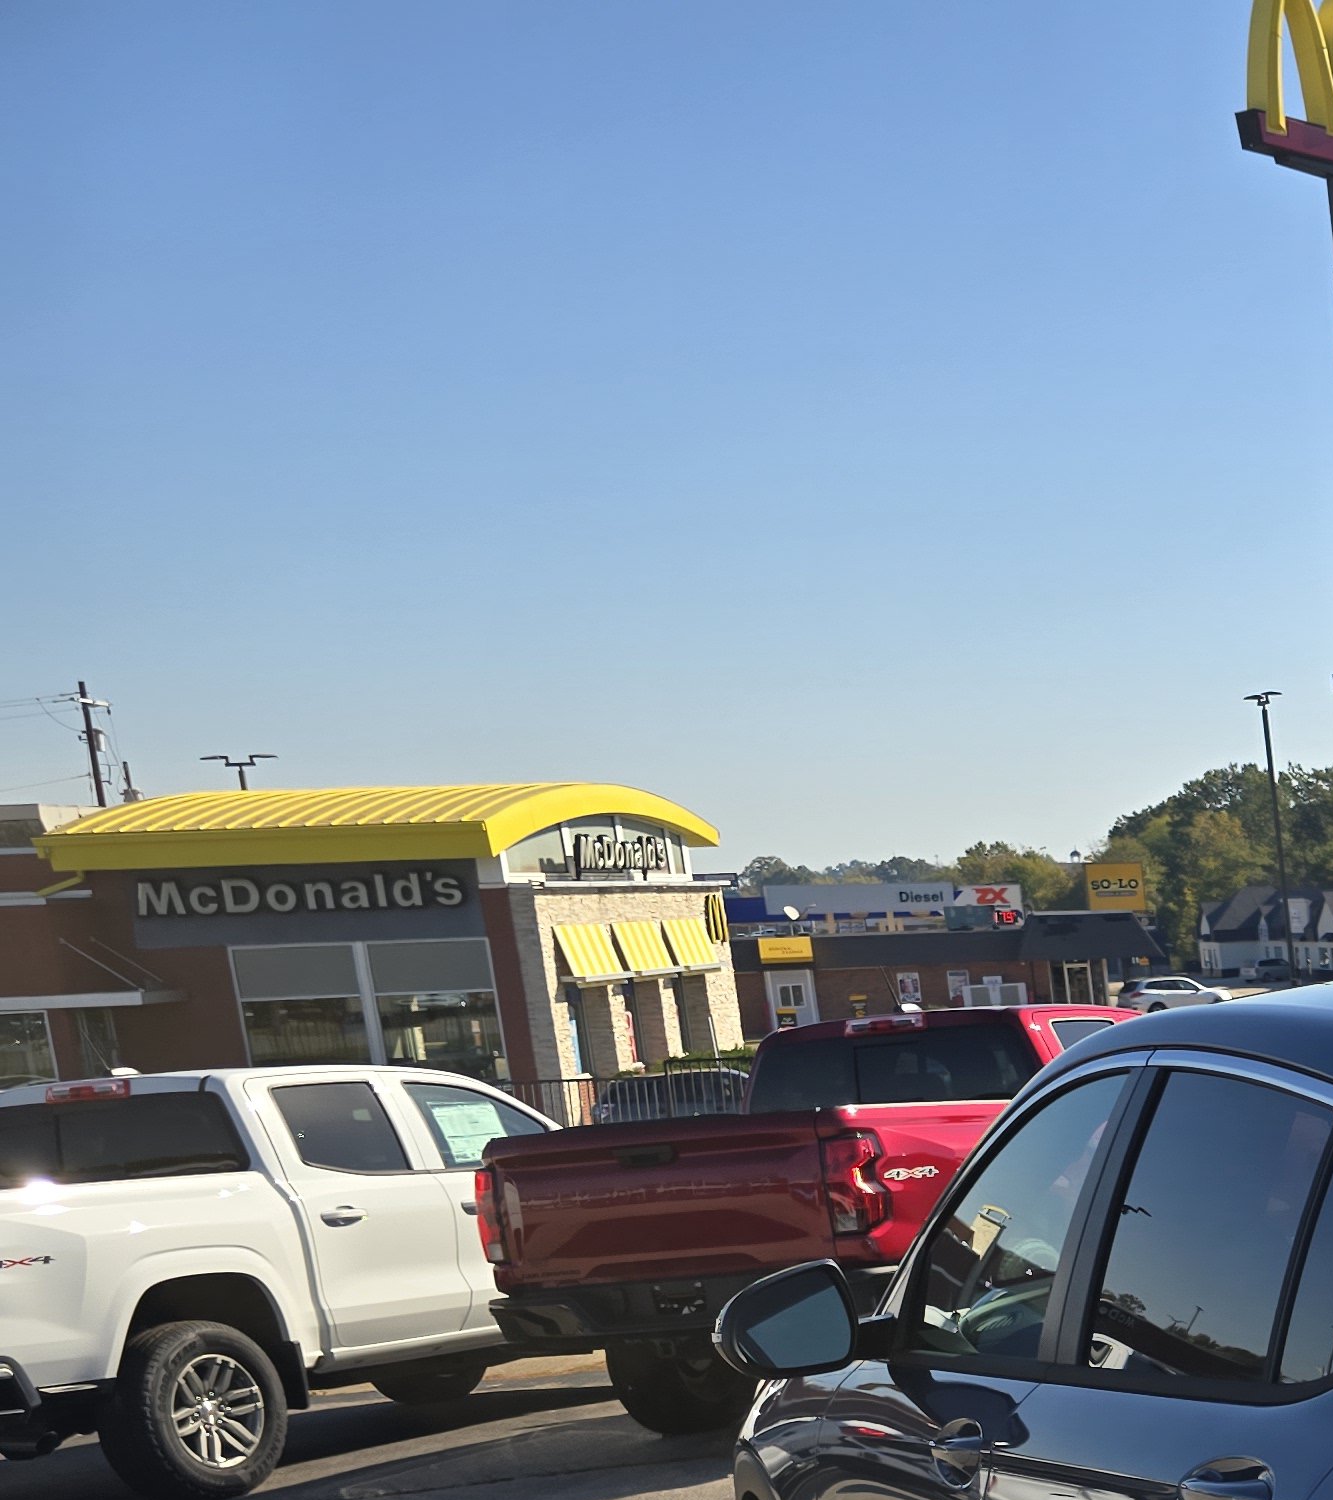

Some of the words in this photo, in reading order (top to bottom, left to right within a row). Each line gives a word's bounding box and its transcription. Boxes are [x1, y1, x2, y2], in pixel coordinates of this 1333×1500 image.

[1091, 878, 1139, 890] SO-LO
[137, 871, 463, 916] McDonald's
[899, 891, 944, 903] Diesel
[0, 1256, 56, 1268] X4
